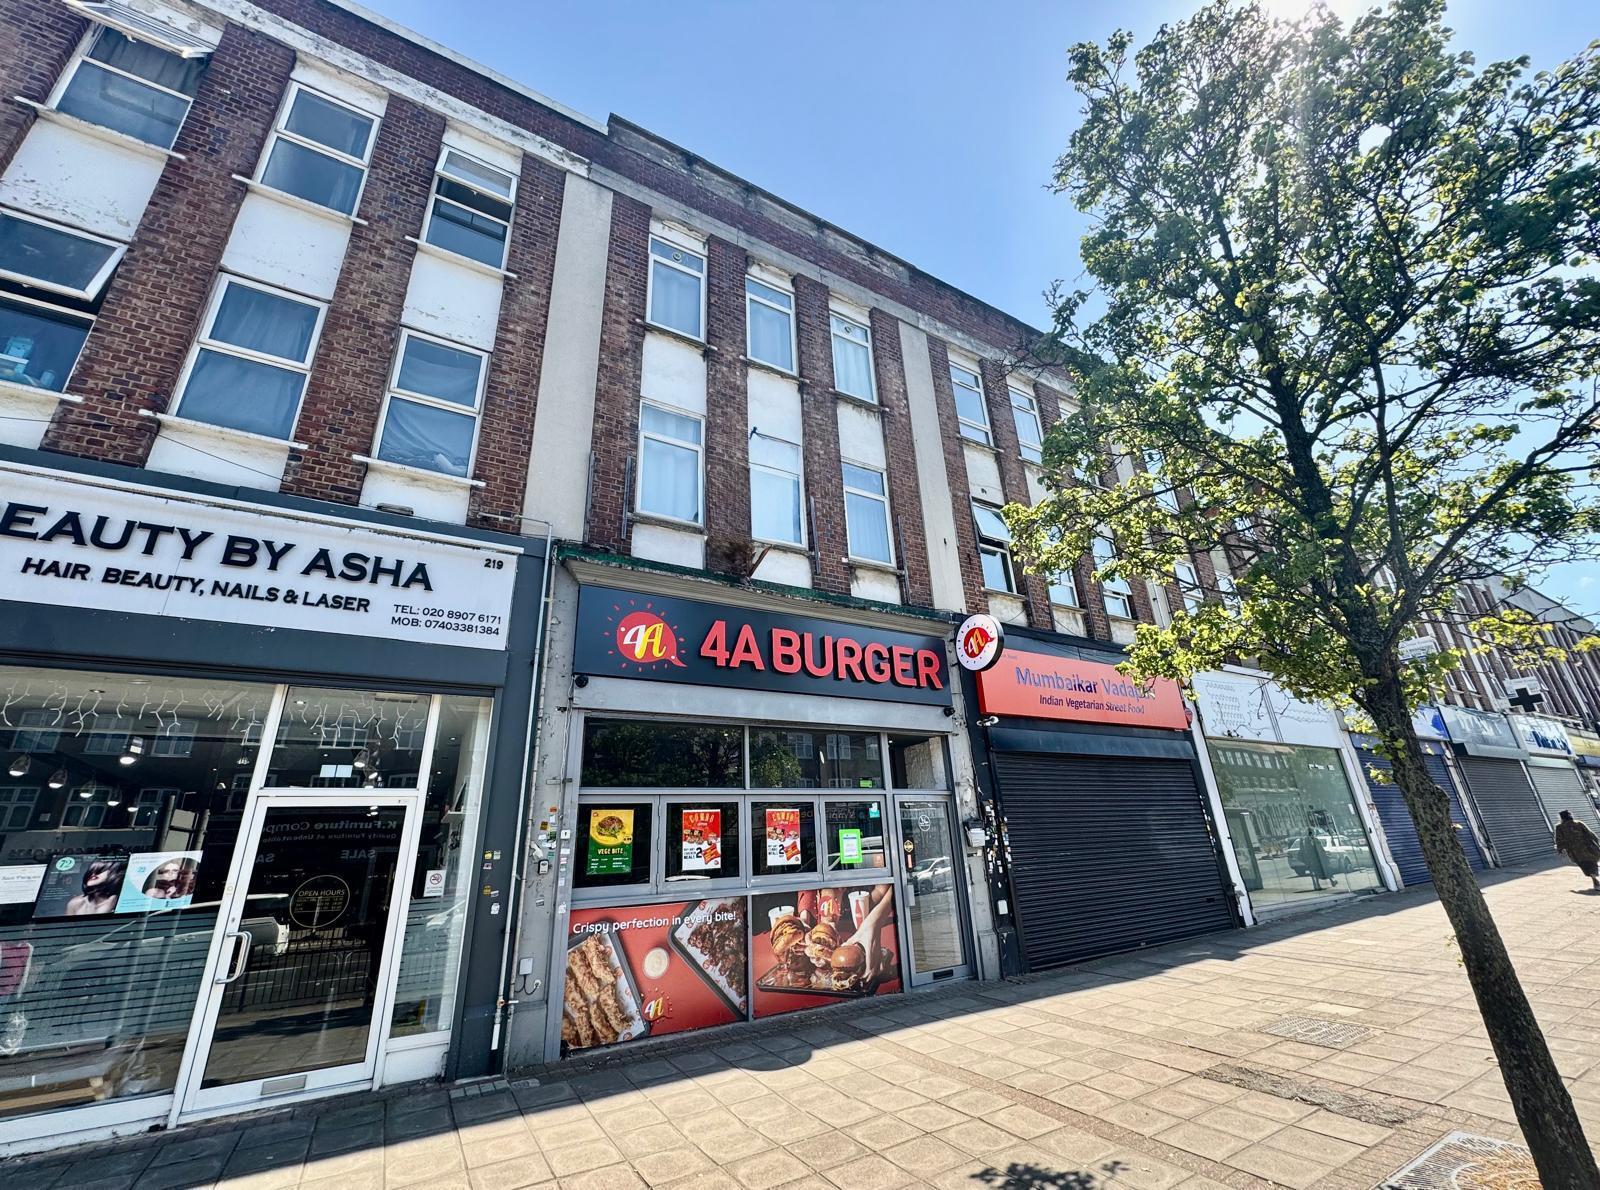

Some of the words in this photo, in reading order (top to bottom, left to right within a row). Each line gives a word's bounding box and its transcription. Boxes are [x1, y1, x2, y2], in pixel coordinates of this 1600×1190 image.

[220, 534, 296, 571] BY
[300, 548, 434, 591] ASHA
[484, 558, 503, 570] 219
[101, 567, 205, 597] BEAUTY,
[210, 580, 280, 602] NAILS
[283, 589, 299, 604] &
[302, 591, 371, 613] LASER
[391, 616, 422, 628] MOB:
[424, 620, 499, 636] 07403381384
[393, 604, 420, 615] TEL:
[422, 607, 444, 617] 020
[447, 610, 476, 621] 8907
[478, 614, 501, 625] 6171
[700, 619, 766, 671] 4A
[771, 627, 944, 690] BURGER
[1015, 666, 1098, 694] Mumbaikar
[1101, 678, 1155, 702] Vadap
[1039, 694, 1064, 706] Indian
[1066, 697, 1105, 711] Vegetarian
[1106, 702, 1127, 713] Street
[1128, 703, 1145, 714] Food
[573, 920, 609, 934] Crispy
[612, 917, 669, 931] perfection
[672, 915, 682, 925] in
[684, 913, 713, 925] every
[715, 911, 737, 922] bite!
